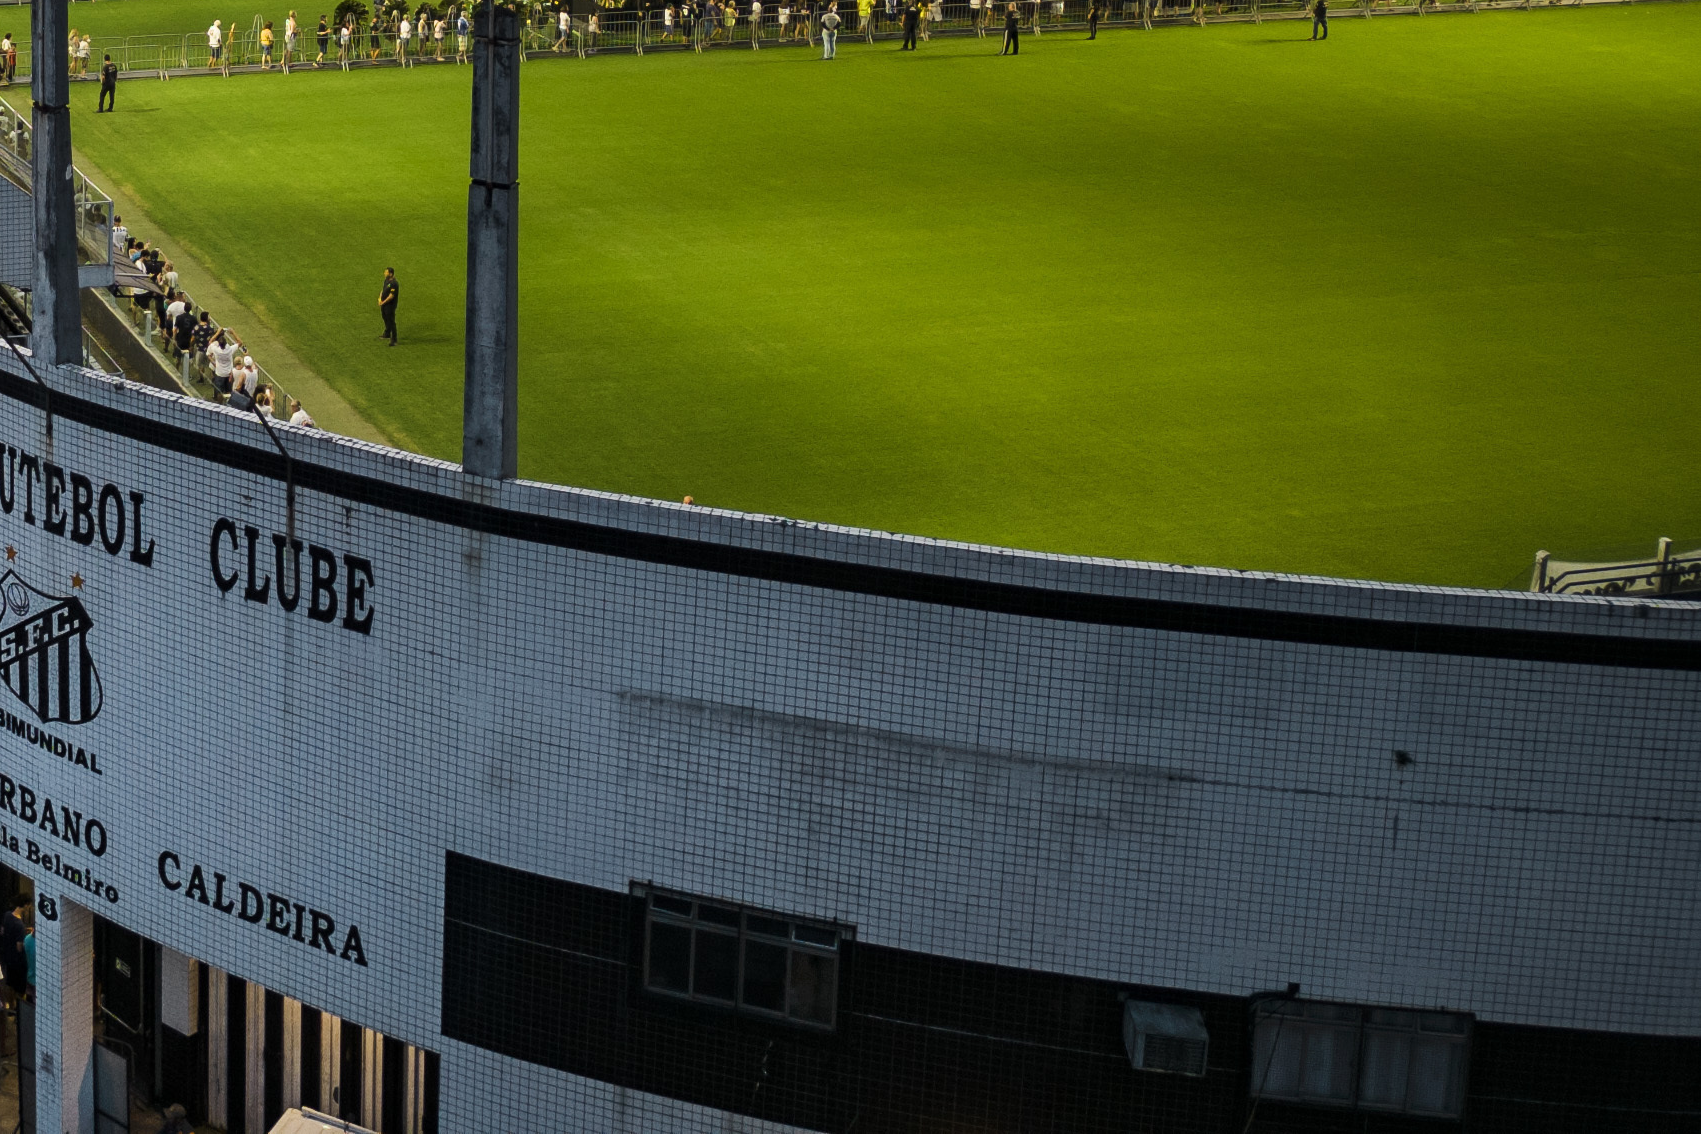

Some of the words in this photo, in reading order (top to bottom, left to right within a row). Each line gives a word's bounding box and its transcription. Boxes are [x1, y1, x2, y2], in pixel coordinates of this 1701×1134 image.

[210, 517, 375, 635] CLUBE
[1, 607, 80, 663] S.F.C.
[26, 838, 119, 903] Belmiro
[158, 850, 368, 966] CALDEIRA
